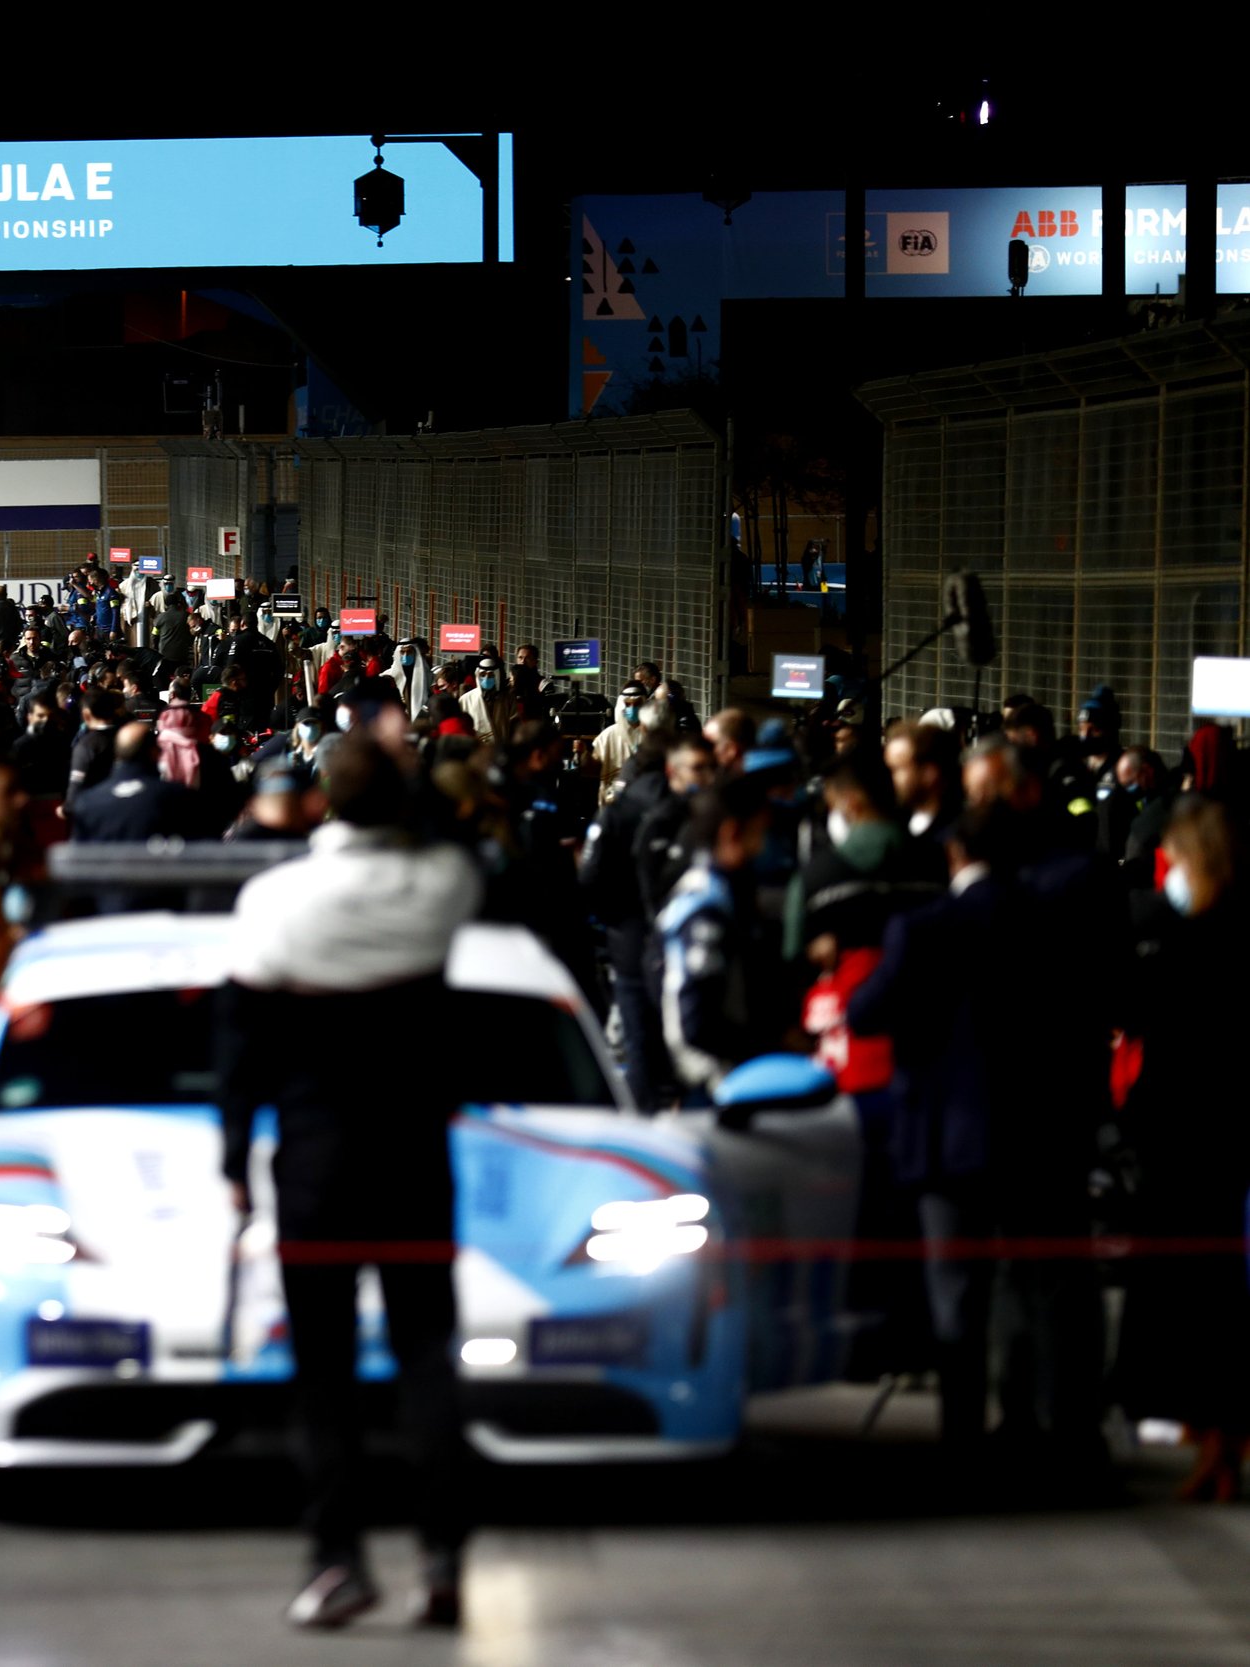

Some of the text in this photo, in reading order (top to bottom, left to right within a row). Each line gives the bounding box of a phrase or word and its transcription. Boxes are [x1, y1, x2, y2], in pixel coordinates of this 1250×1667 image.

[86, 162, 113, 200] E
[1010, 207, 1250, 238] ABB FRMLA
[1056, 251, 1100, 265] WOR
[224, 531, 236, 552] F
